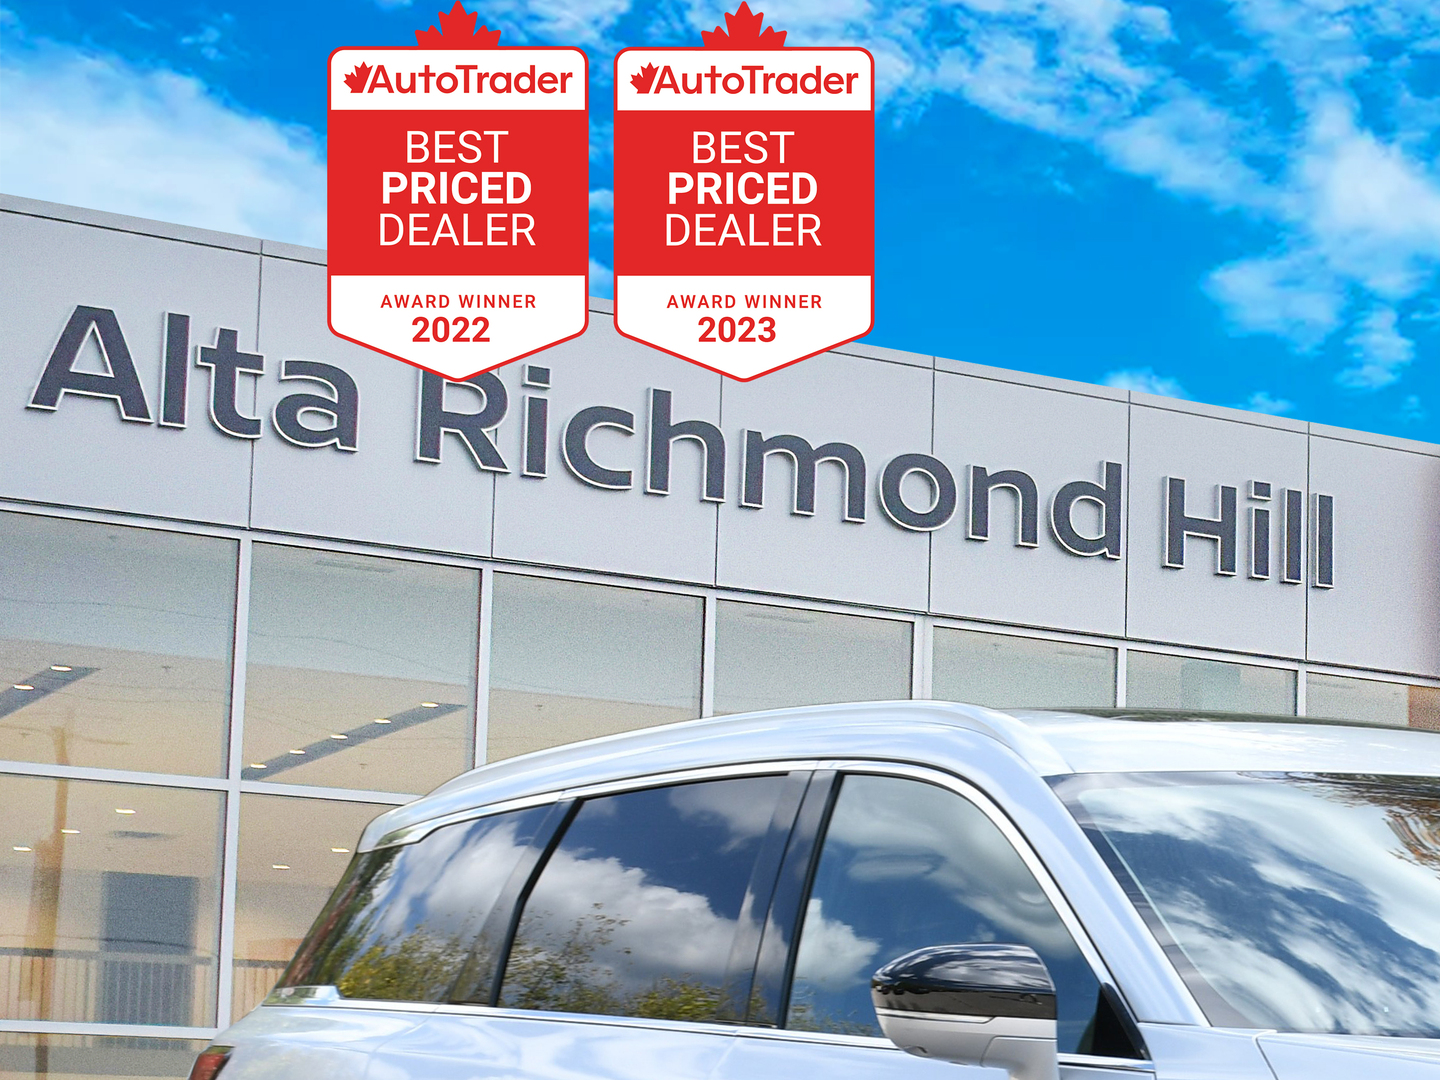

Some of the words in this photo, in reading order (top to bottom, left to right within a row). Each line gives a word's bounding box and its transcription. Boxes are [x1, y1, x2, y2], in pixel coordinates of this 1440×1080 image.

[27, 304, 360, 452] Alta
[413, 364, 1122, 560] Richmond
[1162, 474, 1335, 588] Hill
